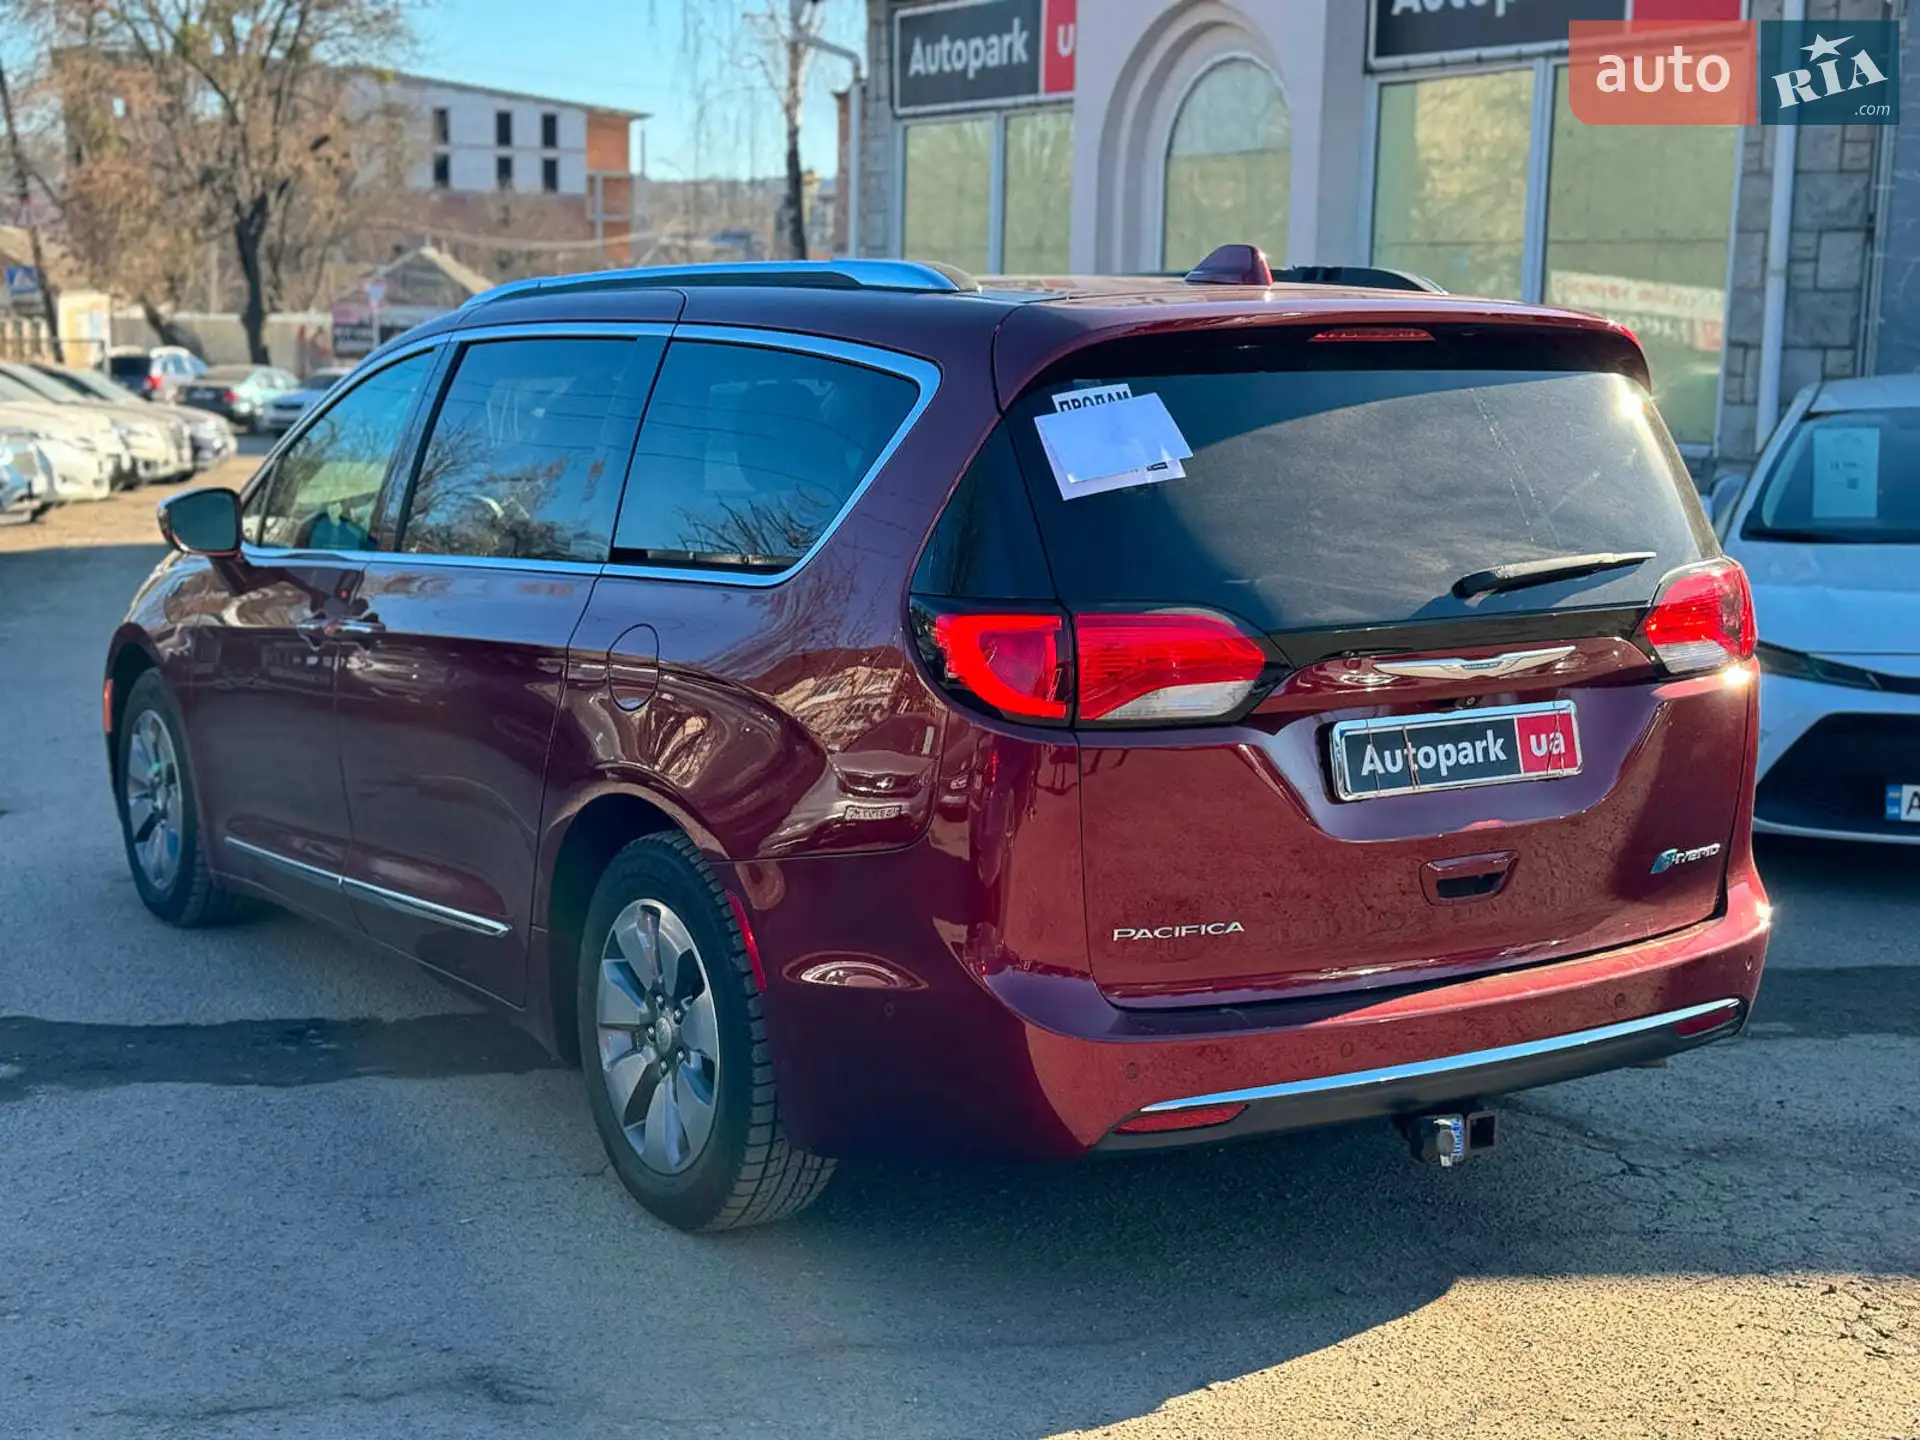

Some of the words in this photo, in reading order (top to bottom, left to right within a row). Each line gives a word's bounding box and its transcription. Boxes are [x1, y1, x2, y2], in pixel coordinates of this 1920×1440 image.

[907, 17, 1028, 79] Autopark
[1057, 23, 1075, 57] u
[1361, 729, 1508, 777] Autopark
[1529, 729, 1566, 757] ua
[1113, 920, 1245, 942] PACIFICA
